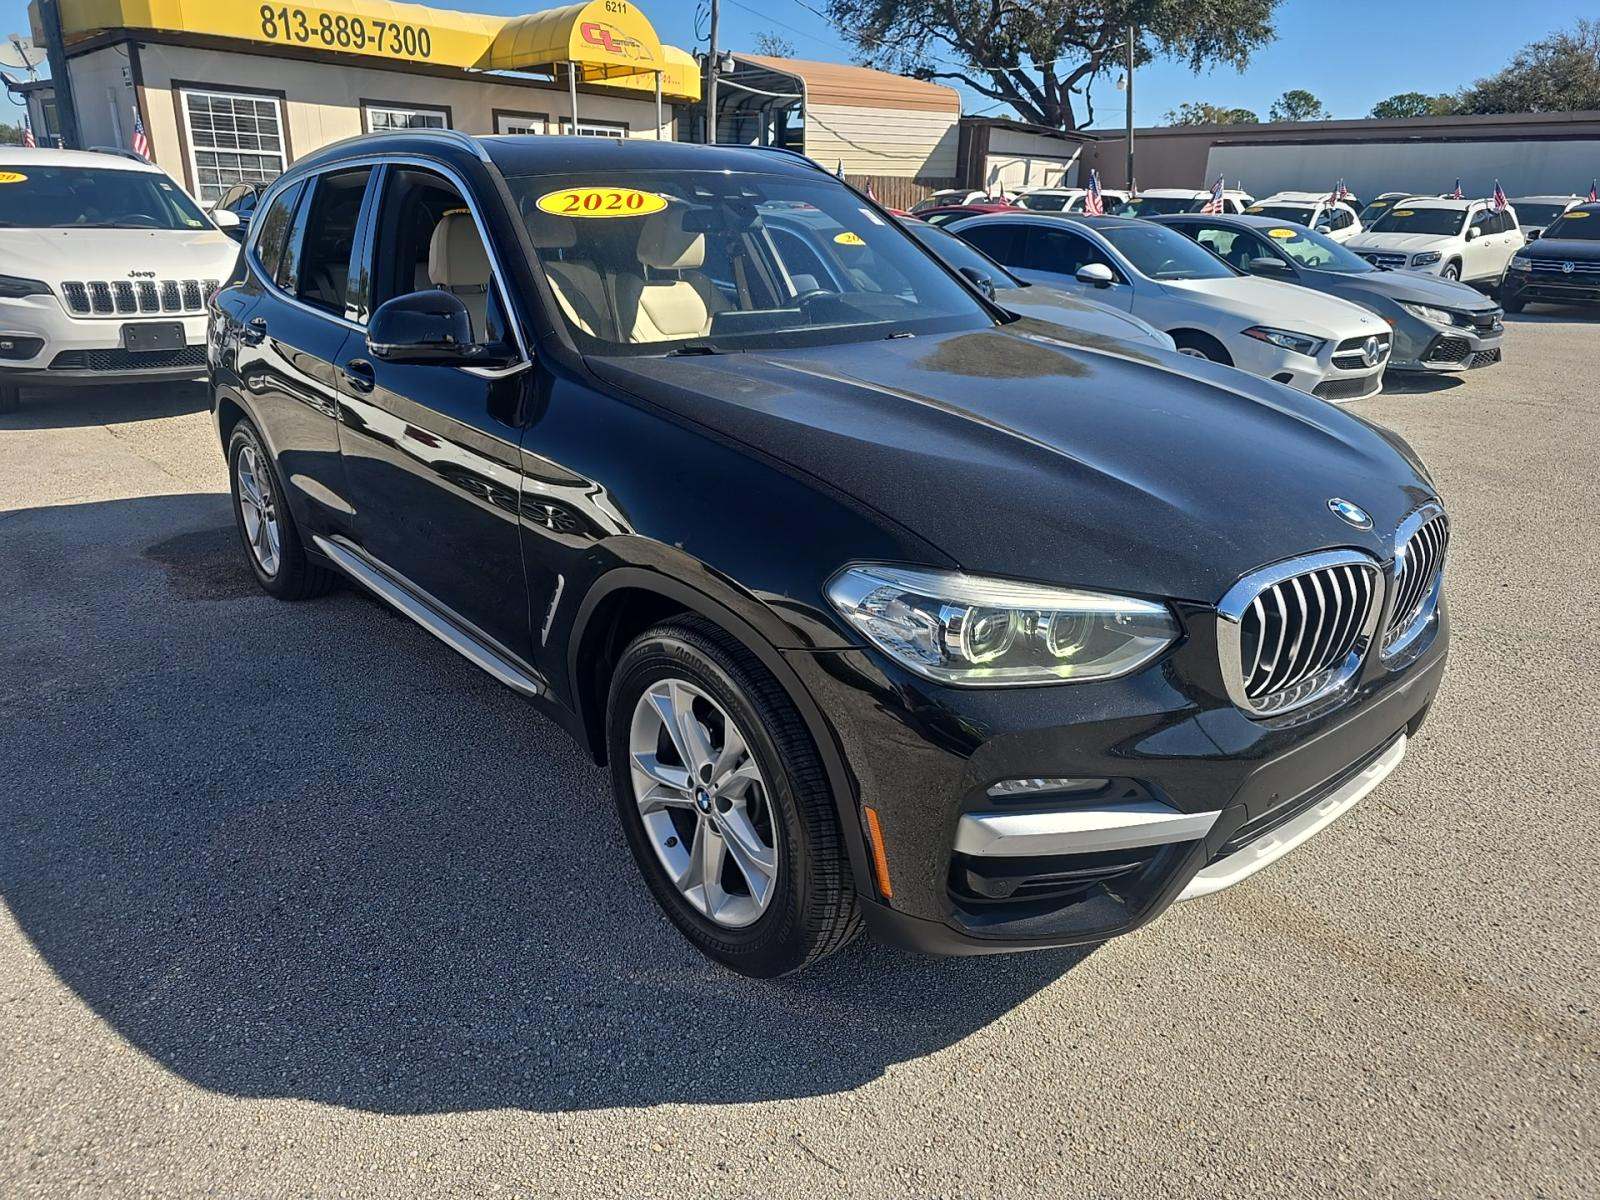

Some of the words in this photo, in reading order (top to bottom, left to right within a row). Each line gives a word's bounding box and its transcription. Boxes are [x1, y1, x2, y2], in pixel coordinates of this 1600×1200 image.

[605, 1, 627, 14] 6211
[260, 4, 431, 58] 813-889-7300
[563, 193, 645, 212] 2020
[128, 270, 156, 278] Jeep
